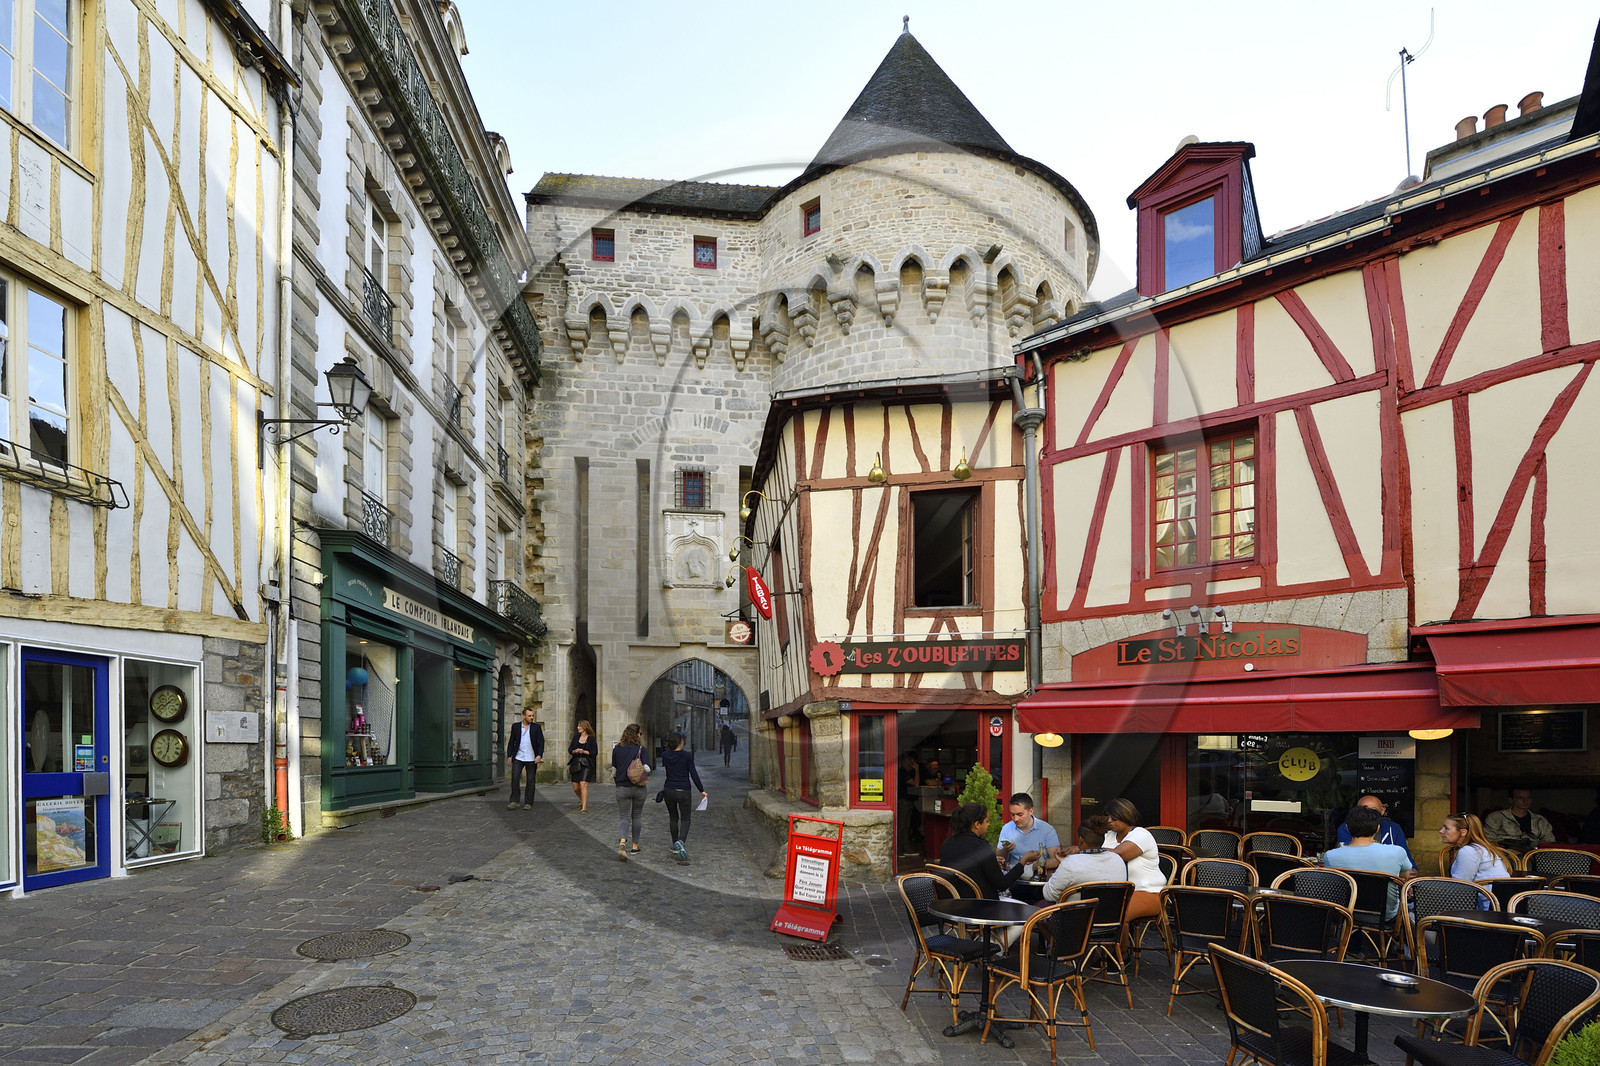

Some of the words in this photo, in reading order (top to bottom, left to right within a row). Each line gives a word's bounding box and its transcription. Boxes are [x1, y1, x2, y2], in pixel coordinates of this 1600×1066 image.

[752, 576, 769, 610] TABAC
[391, 594, 400, 609] LE
[404, 600, 438, 626] COMPTOIR
[441, 616, 469, 639] IRLANDAIS
[1118, 642, 1152, 664] Le
[1158, 638, 1186, 662] St
[1194, 631, 1299, 660] Nicolas
[855, 648, 882, 668] Les
[1281, 758, 1316, 771] CLUB
[803, 845, 832, 855] Télégramme
[784, 921, 825, 936] Télégramme
